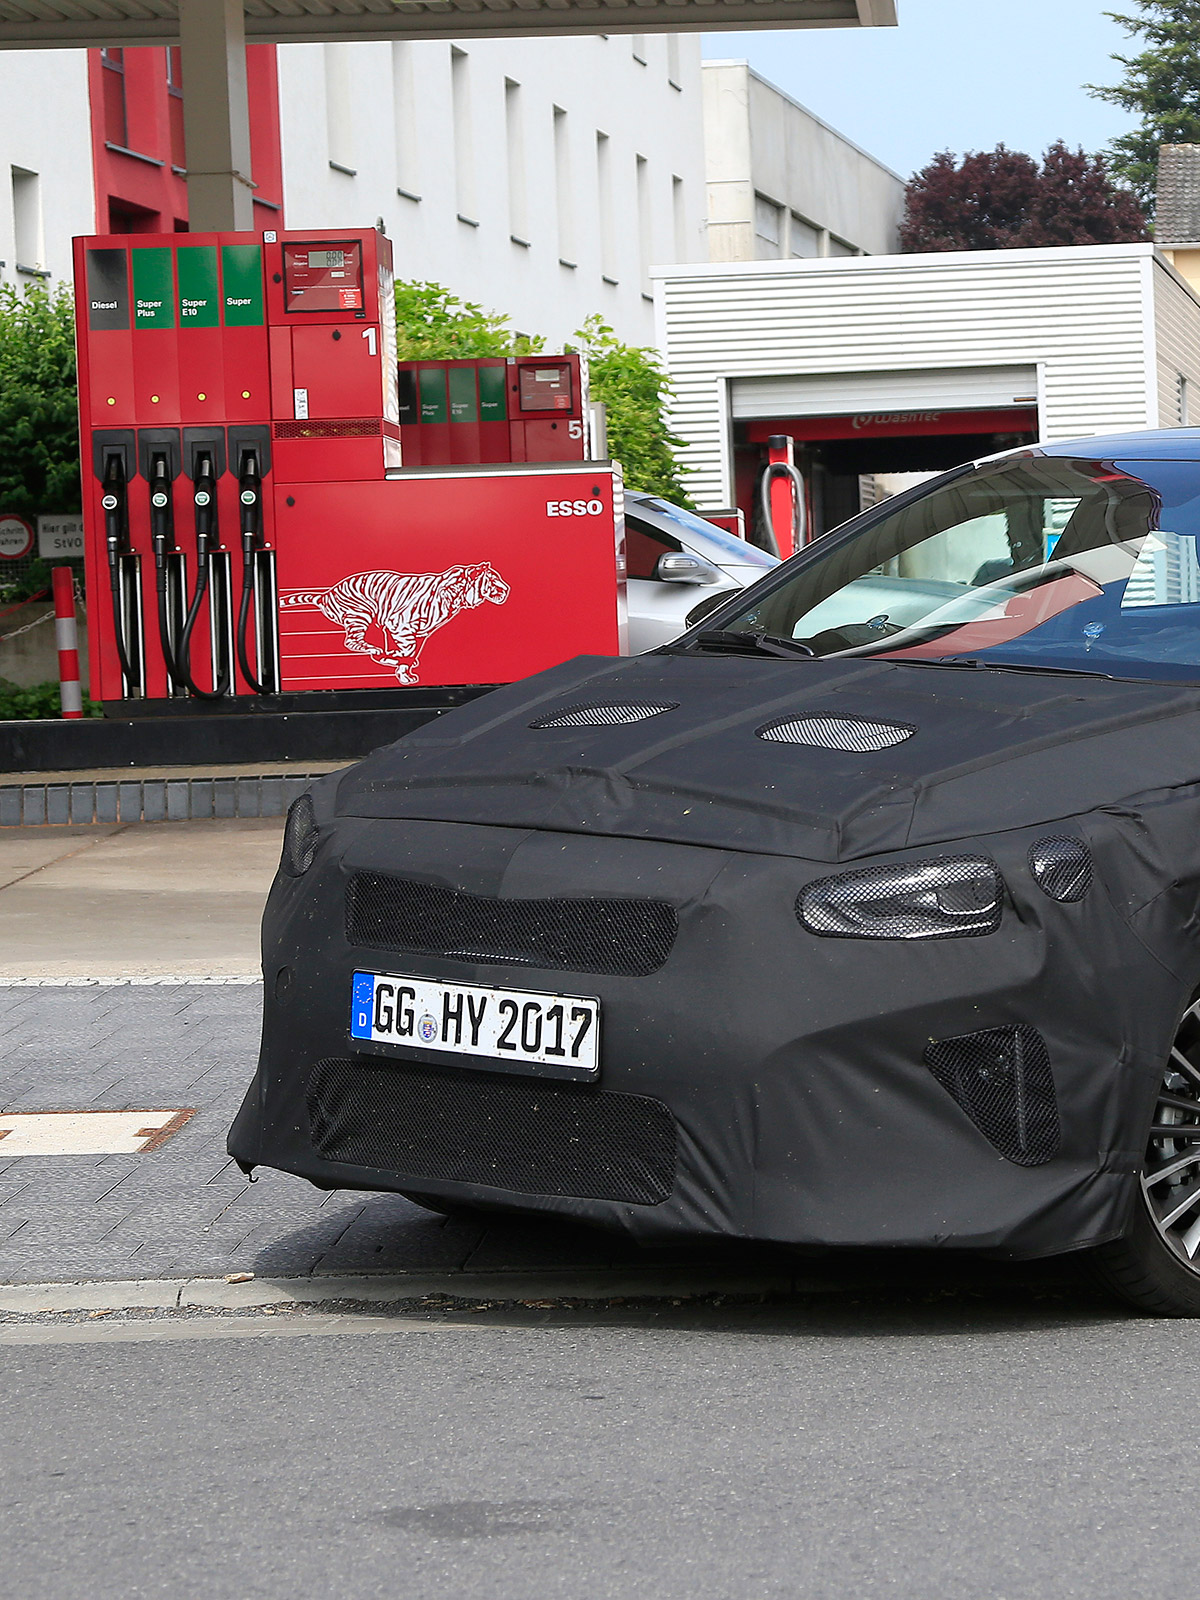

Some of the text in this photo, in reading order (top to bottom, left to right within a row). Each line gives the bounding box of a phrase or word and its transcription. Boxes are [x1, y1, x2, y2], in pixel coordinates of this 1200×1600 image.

[91, 301, 118, 309] Diesel
[137, 300, 162, 309] Super
[182, 299, 207, 308] Super
[226, 297, 252, 306] Super
[137, 309, 156, 317] Plus
[182, 308, 198, 316] E10
[362, 327, 377, 356] 1
[568, 419, 582, 440] 5
[546, 499, 604, 517] ESSO
[54, 537, 82, 549] StVO
[358, 1012, 367, 1027] D
[375, 983, 592, 1058] GG HY 2017
